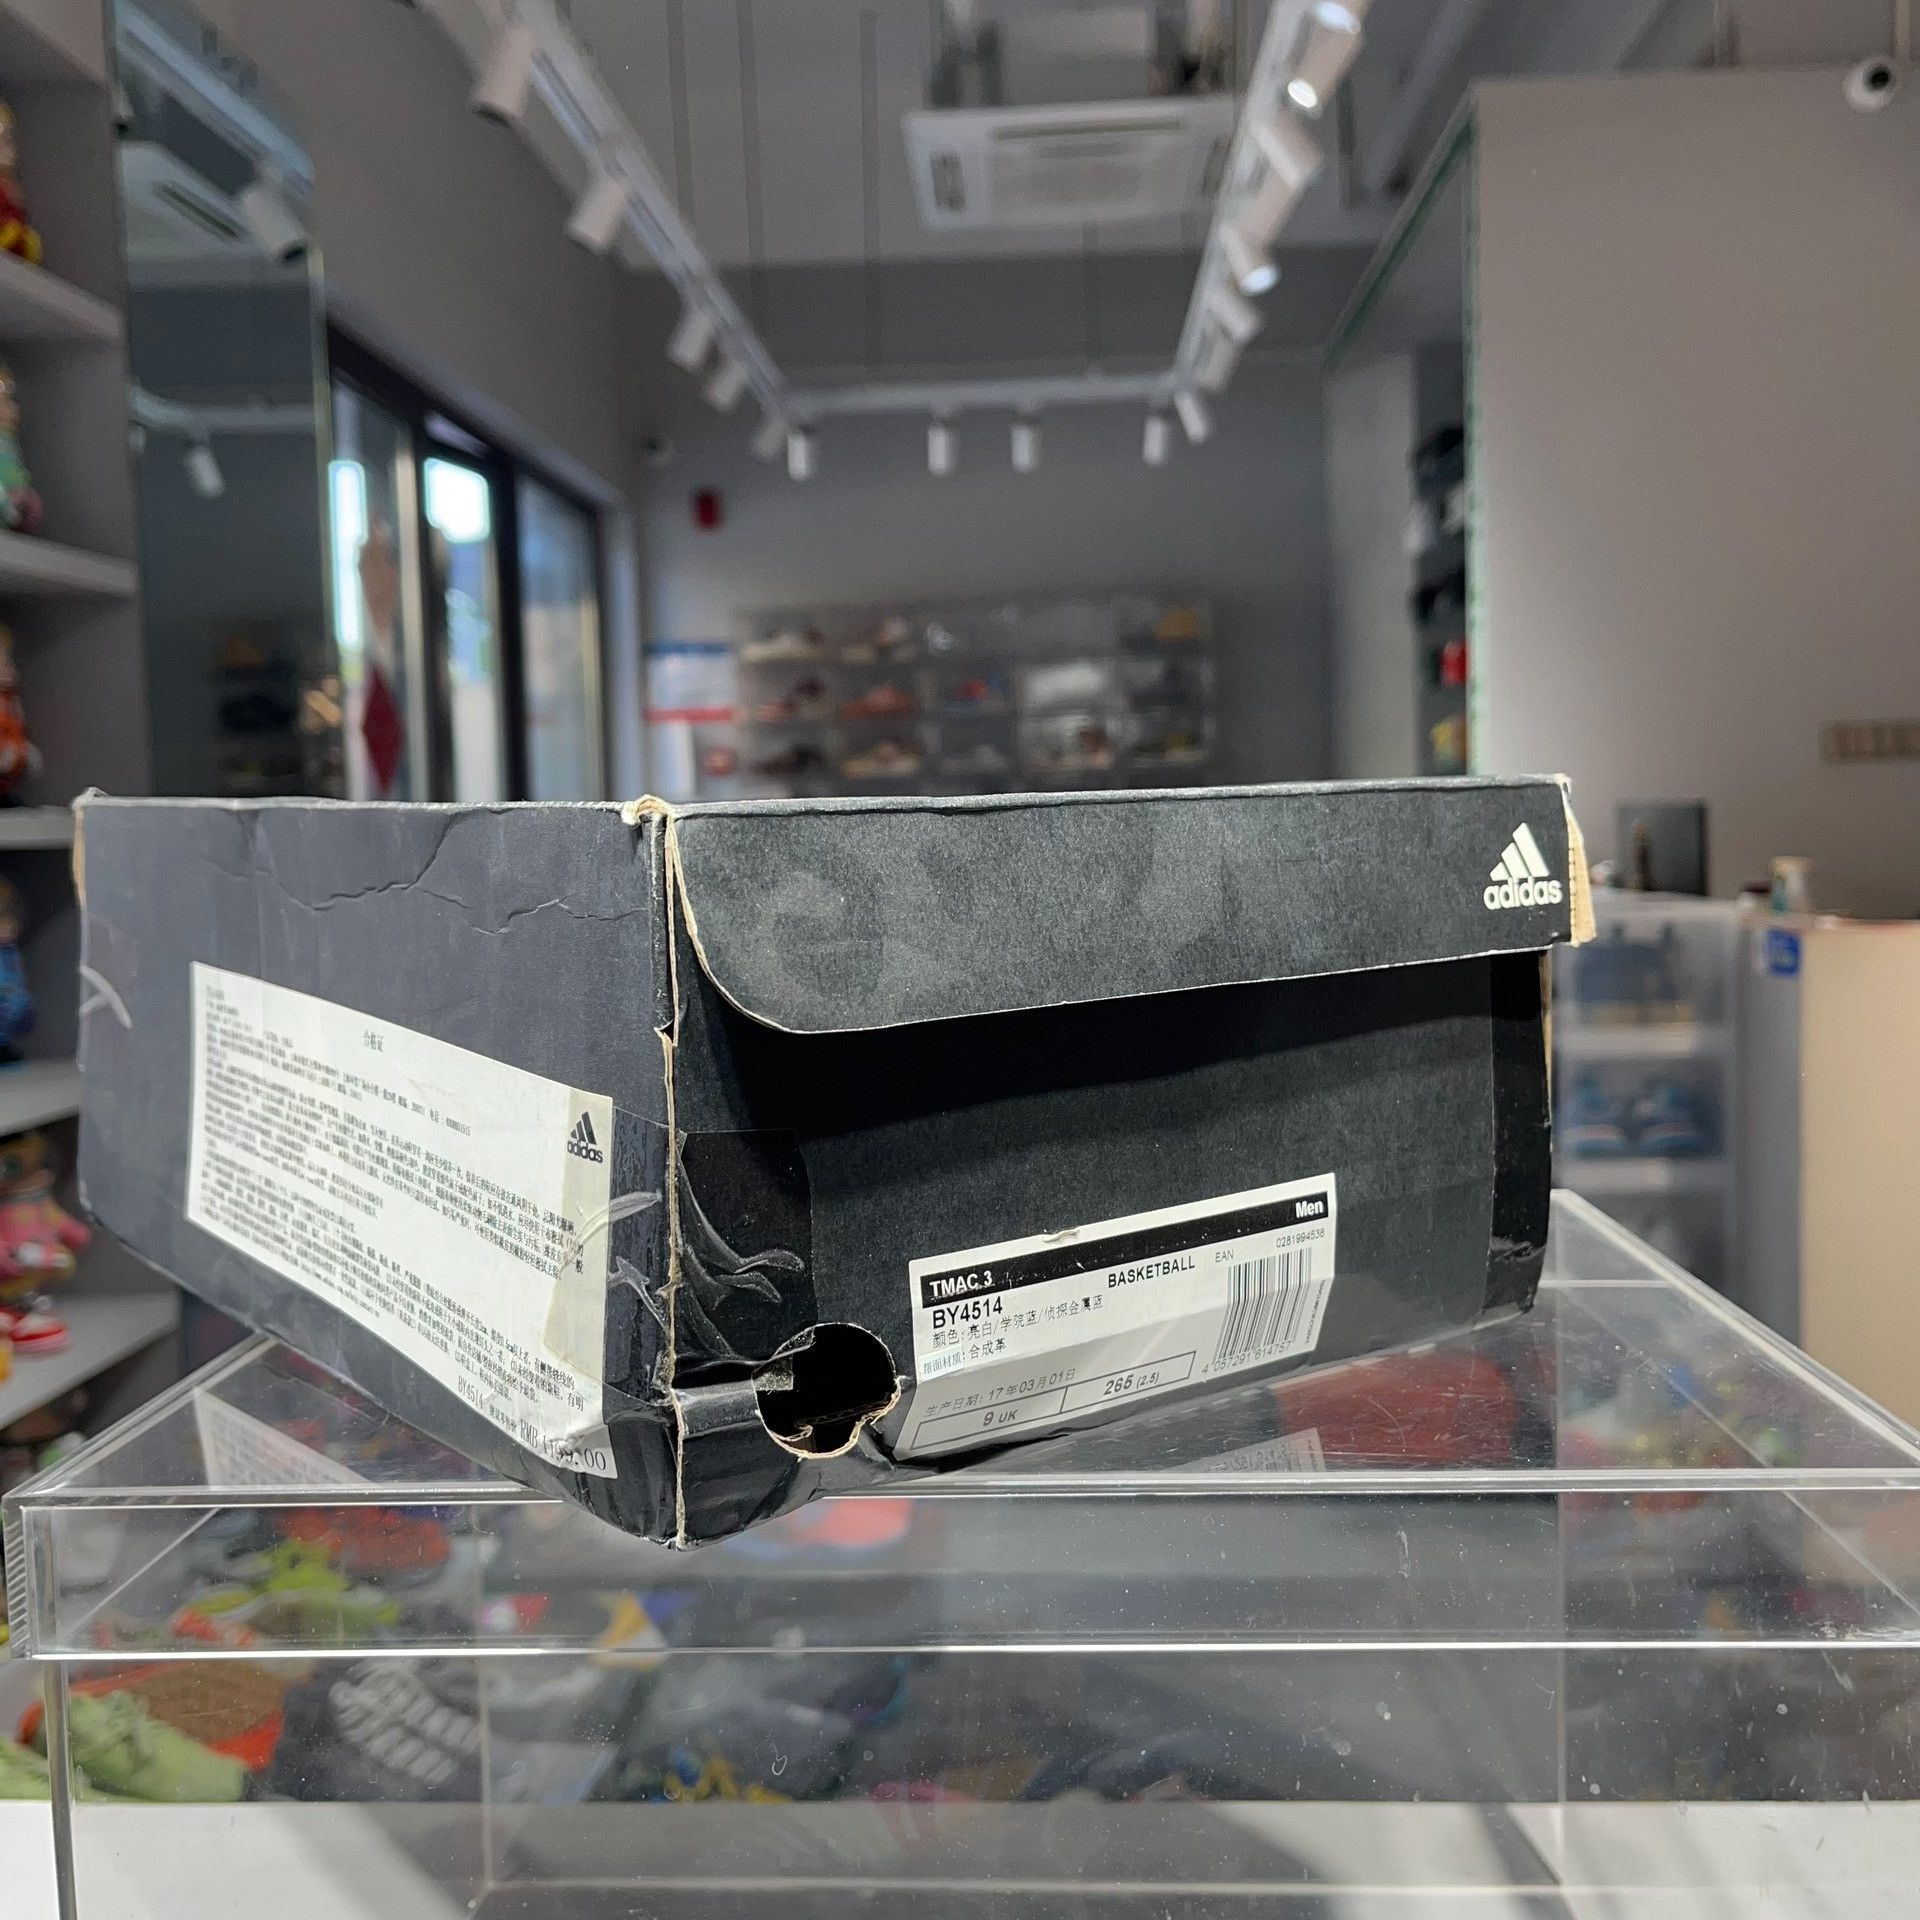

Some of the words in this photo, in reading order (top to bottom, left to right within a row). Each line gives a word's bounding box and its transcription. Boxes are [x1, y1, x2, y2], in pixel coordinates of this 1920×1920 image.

[1484, 875, 1562, 910] adidas
[567, 1139, 603, 1163] adidas
[1295, 1200, 1324, 1218] Men
[1215, 1249, 1234, 1263] EAN
[929, 1272, 979, 1297] TMAC
[983, 1270, 994, 1286] 3
[1108, 1256, 1196, 1288] BASKETBALL
[932, 1296, 1003, 1329] BY4514
[1202, 1363, 1209, 1375] 4
[458, 1374, 483, 1409] BY4514
[1103, 1374, 1133, 1396] 265
[1136, 1372, 1160, 1390] (2.5)
[983, 1411, 995, 1426] 9
[998, 1409, 1019, 1423] UK
[520, 1418, 538, 1448] RMB
